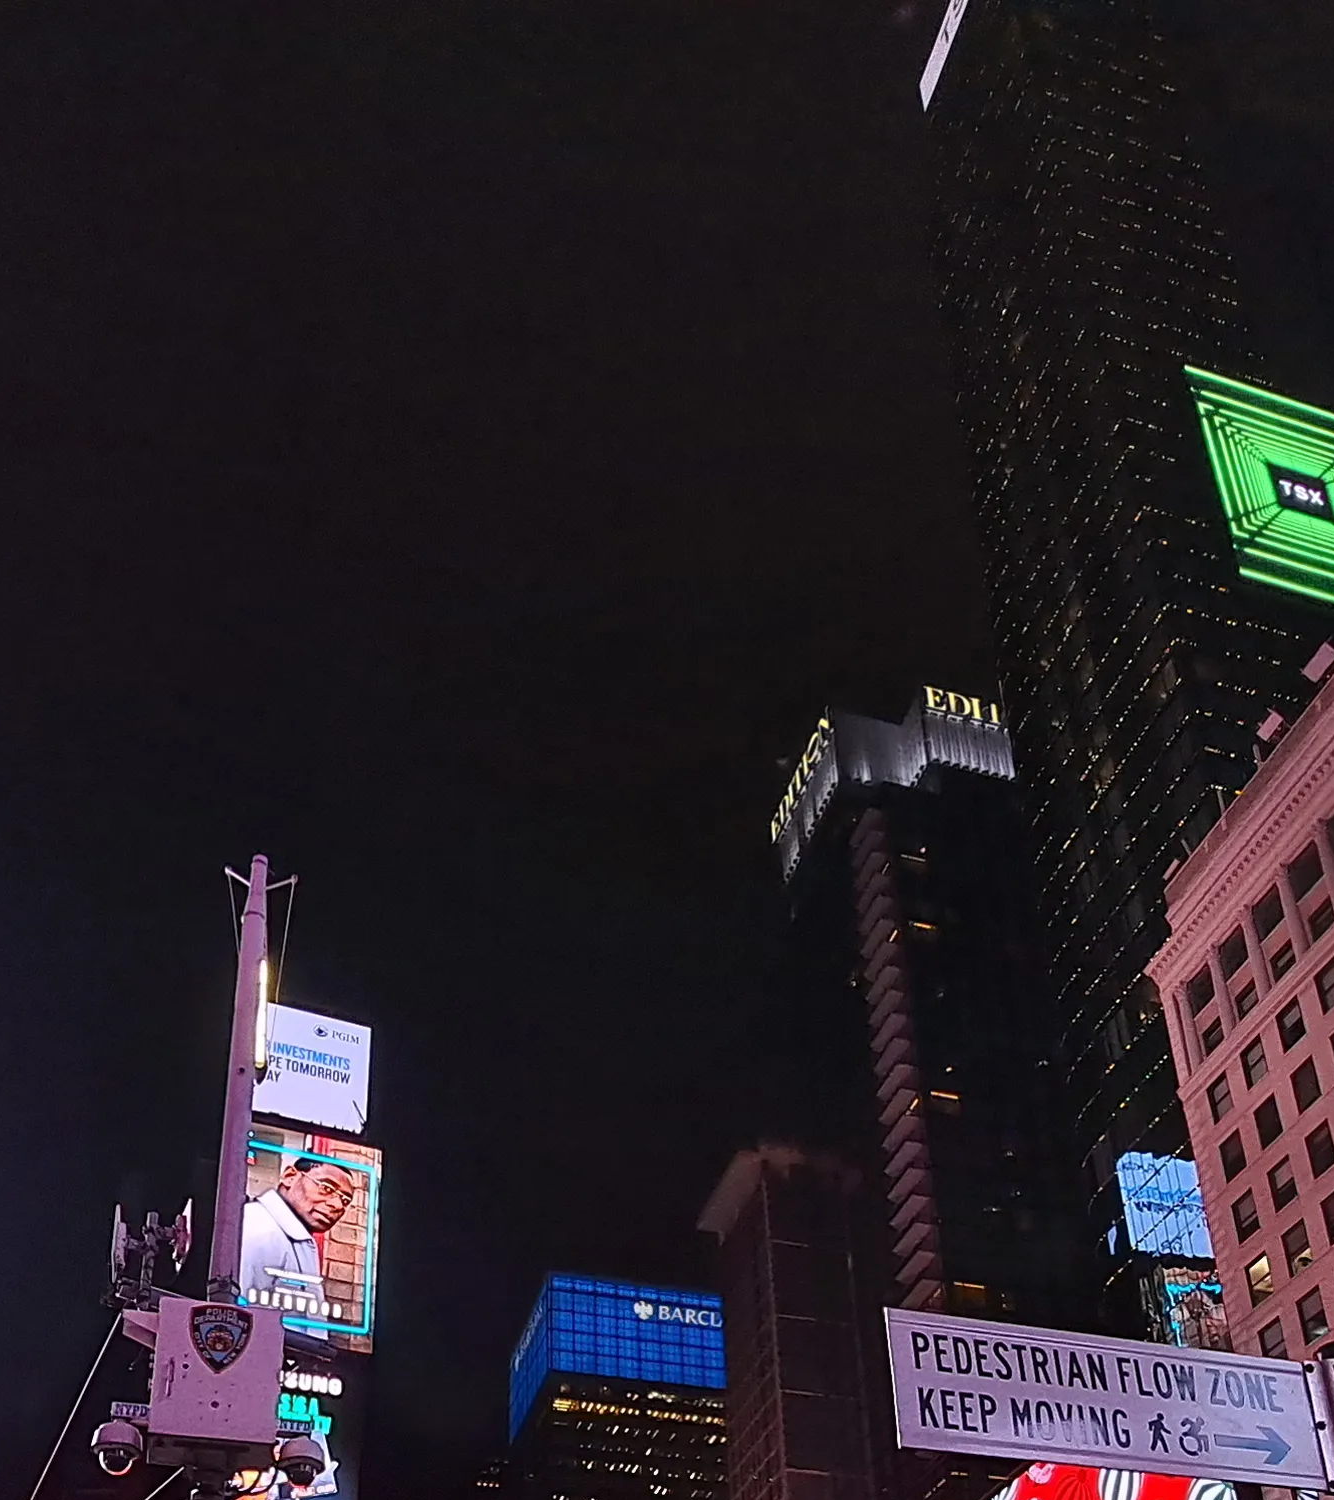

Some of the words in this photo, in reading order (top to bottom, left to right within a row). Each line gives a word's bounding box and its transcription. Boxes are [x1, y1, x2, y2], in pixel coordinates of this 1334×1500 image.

[1278, 477, 1325, 507] TSX
[331, 1028, 361, 1045] PGIM
[272, 1040, 351, 1071] INVESTMENTS
[284, 1057, 351, 1085] TOMORROW
[910, 1330, 1108, 1393] PEDESTRIAN
[1116, 1356, 1198, 1403] FLOW
[1205, 1367, 1286, 1414] ZONE
[114, 1403, 150, 1418] NYPD
[916, 1386, 998, 1434] KEEP
[1011, 1396, 1132, 1450] MOVING
